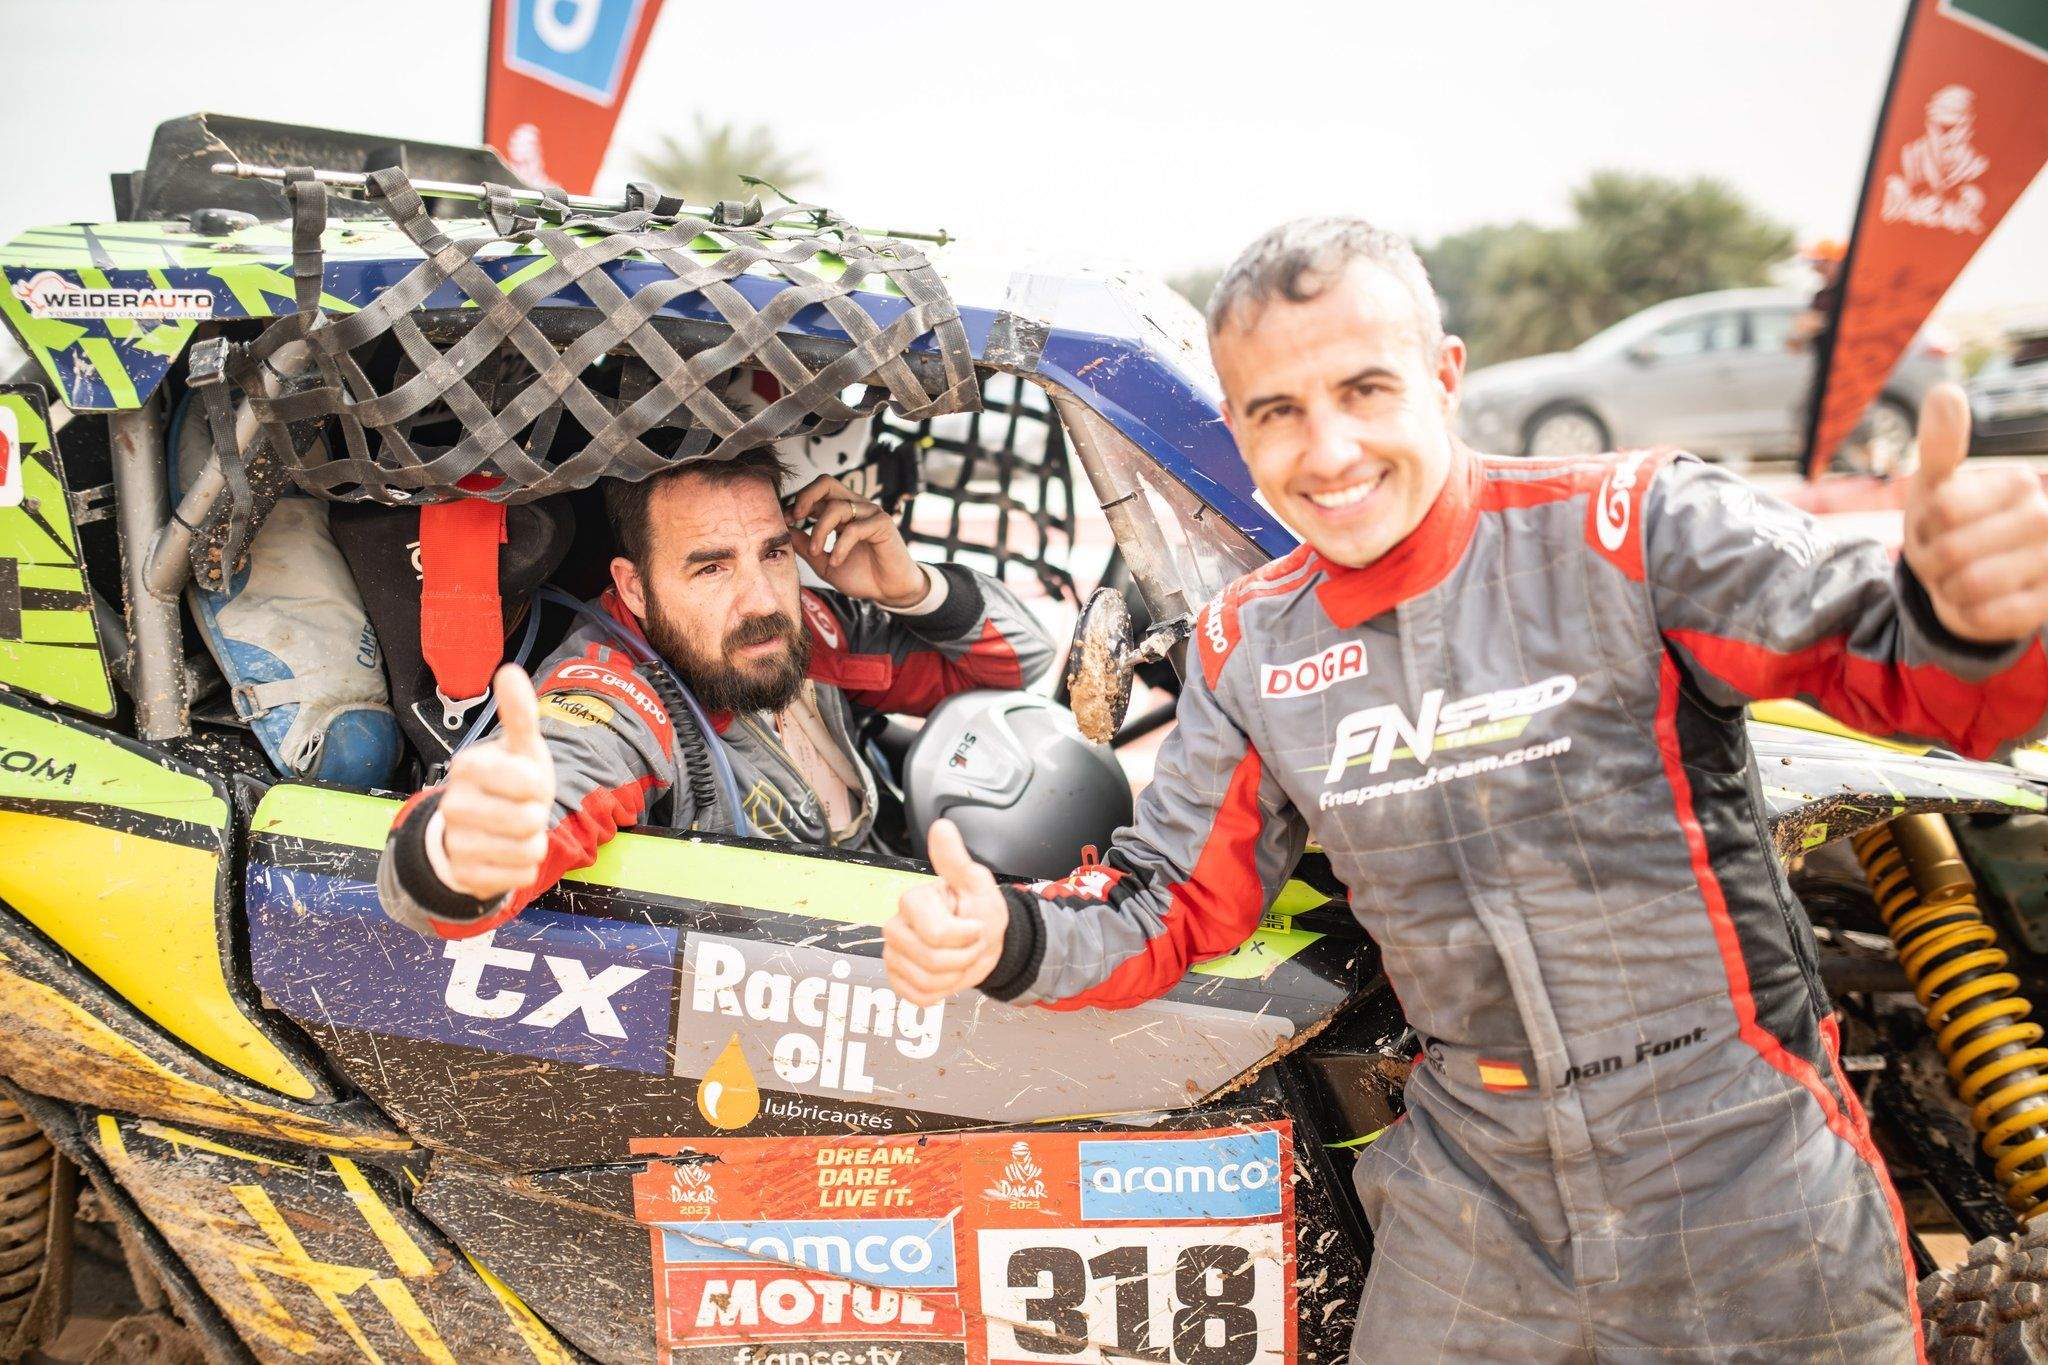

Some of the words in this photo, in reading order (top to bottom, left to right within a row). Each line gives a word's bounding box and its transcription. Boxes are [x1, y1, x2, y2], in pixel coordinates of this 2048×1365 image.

[43, 294, 212, 308] WEIDERAUTO
[1265, 645, 1363, 695] DOGA
[601, 674, 667, 725] galuppo
[0, 746, 77, 785] OM
[1319, 736, 1573, 811] fnspeedteam.com
[691, 940, 945, 1060] Racing
[1635, 1026, 1708, 1064] Font
[764, 1097, 893, 1131] lubricantes
[816, 1148, 921, 1166] DREAM.
[671, 1184, 719, 1204] DAKAR
[817, 1168, 898, 1188] DARE.
[999, 1179, 1049, 1200] DAKAR
[1092, 1161, 1268, 1194] aramco
[680, 1205, 712, 1216] 2023
[818, 1189, 882, 1208] LIVE
[883, 1188, 914, 1207] IT.
[1009, 1201, 1041, 1210] 2023
[694, 1278, 935, 1327] MOTUL
[1006, 1244, 1259, 1365] 318
